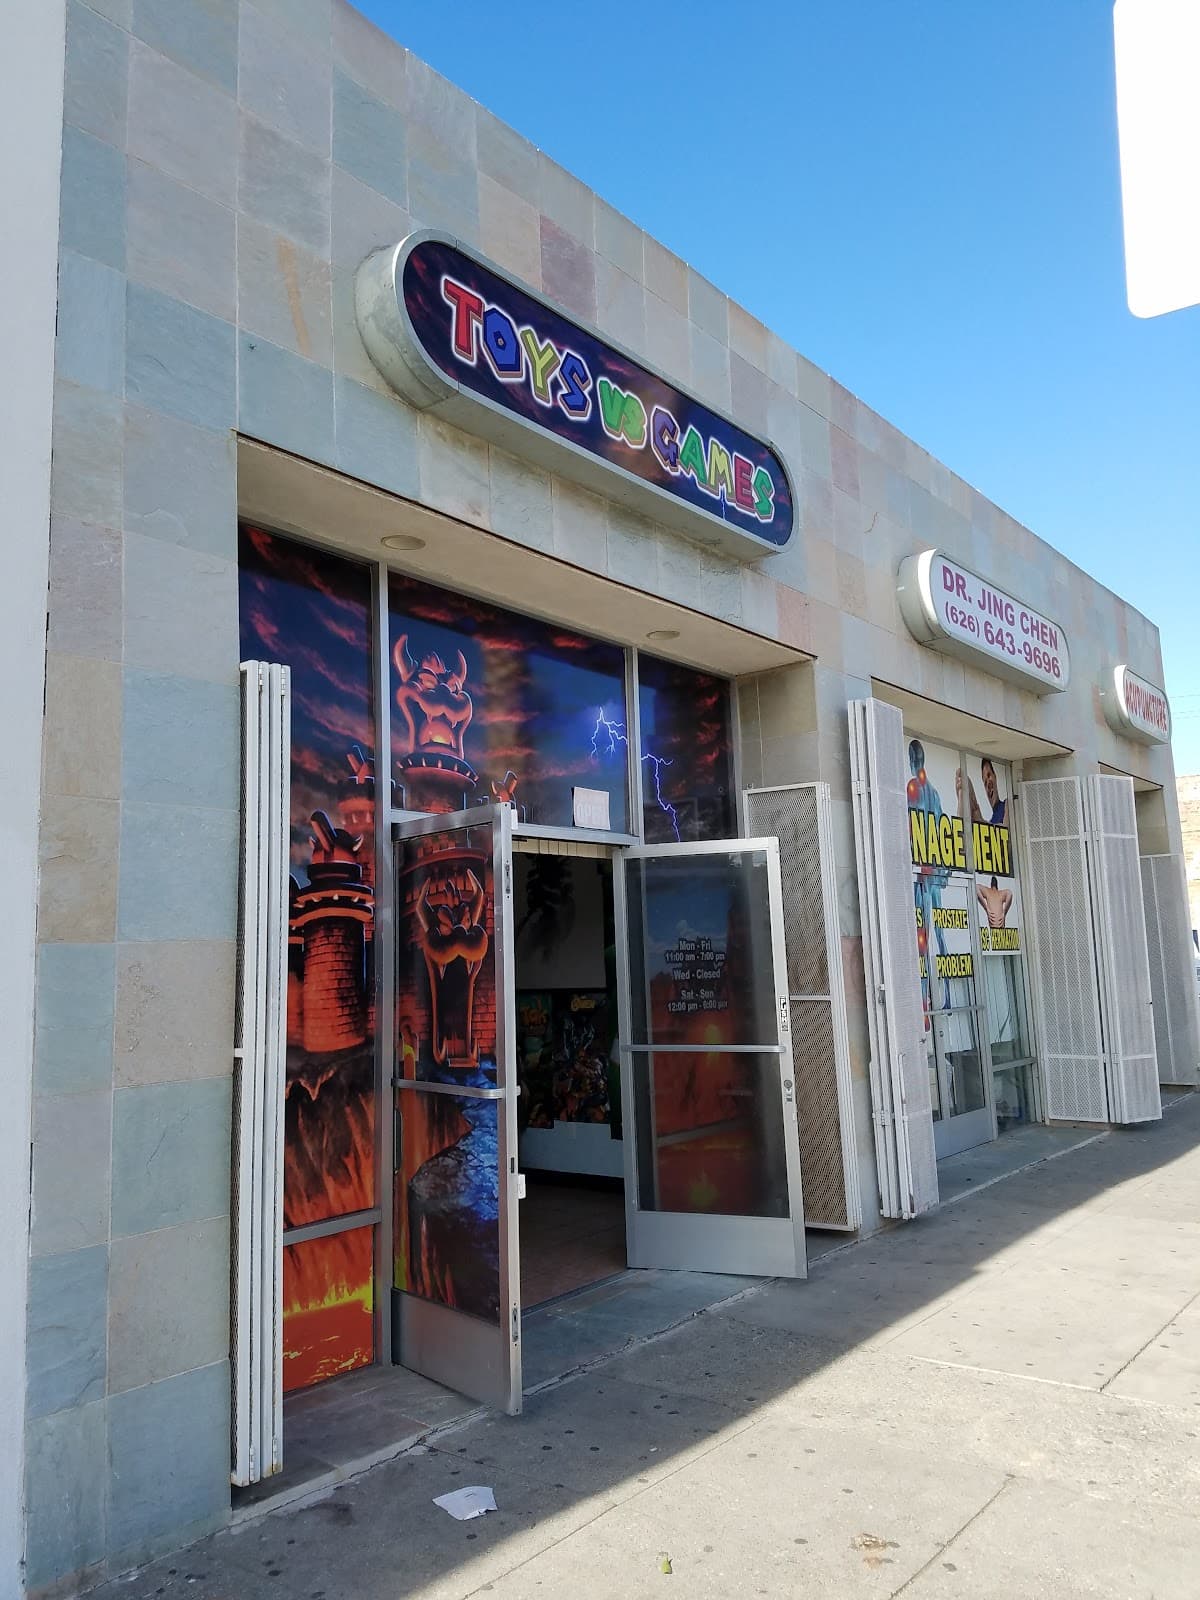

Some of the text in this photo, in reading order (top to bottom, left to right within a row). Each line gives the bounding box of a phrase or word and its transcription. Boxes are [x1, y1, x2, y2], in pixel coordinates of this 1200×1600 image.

[441, 275, 592, 421] TOYS
[650, 407, 775, 522] GAMES
[942, 564, 1058, 652] DR. JING CHEN
[945, 601, 1061, 679] (626) 643-9696
[932, 908, 969, 929] PROSTATE
[679, 940, 695, 951] Mon
[701, 940, 712, 951] Fri
[673, 970, 690, 980] Wed
[696, 969, 721, 979] Closed
[936, 954, 973, 978] PROBLEM
[681, 990, 694, 1000] Sat
[700, 989, 714, 999] Sun
